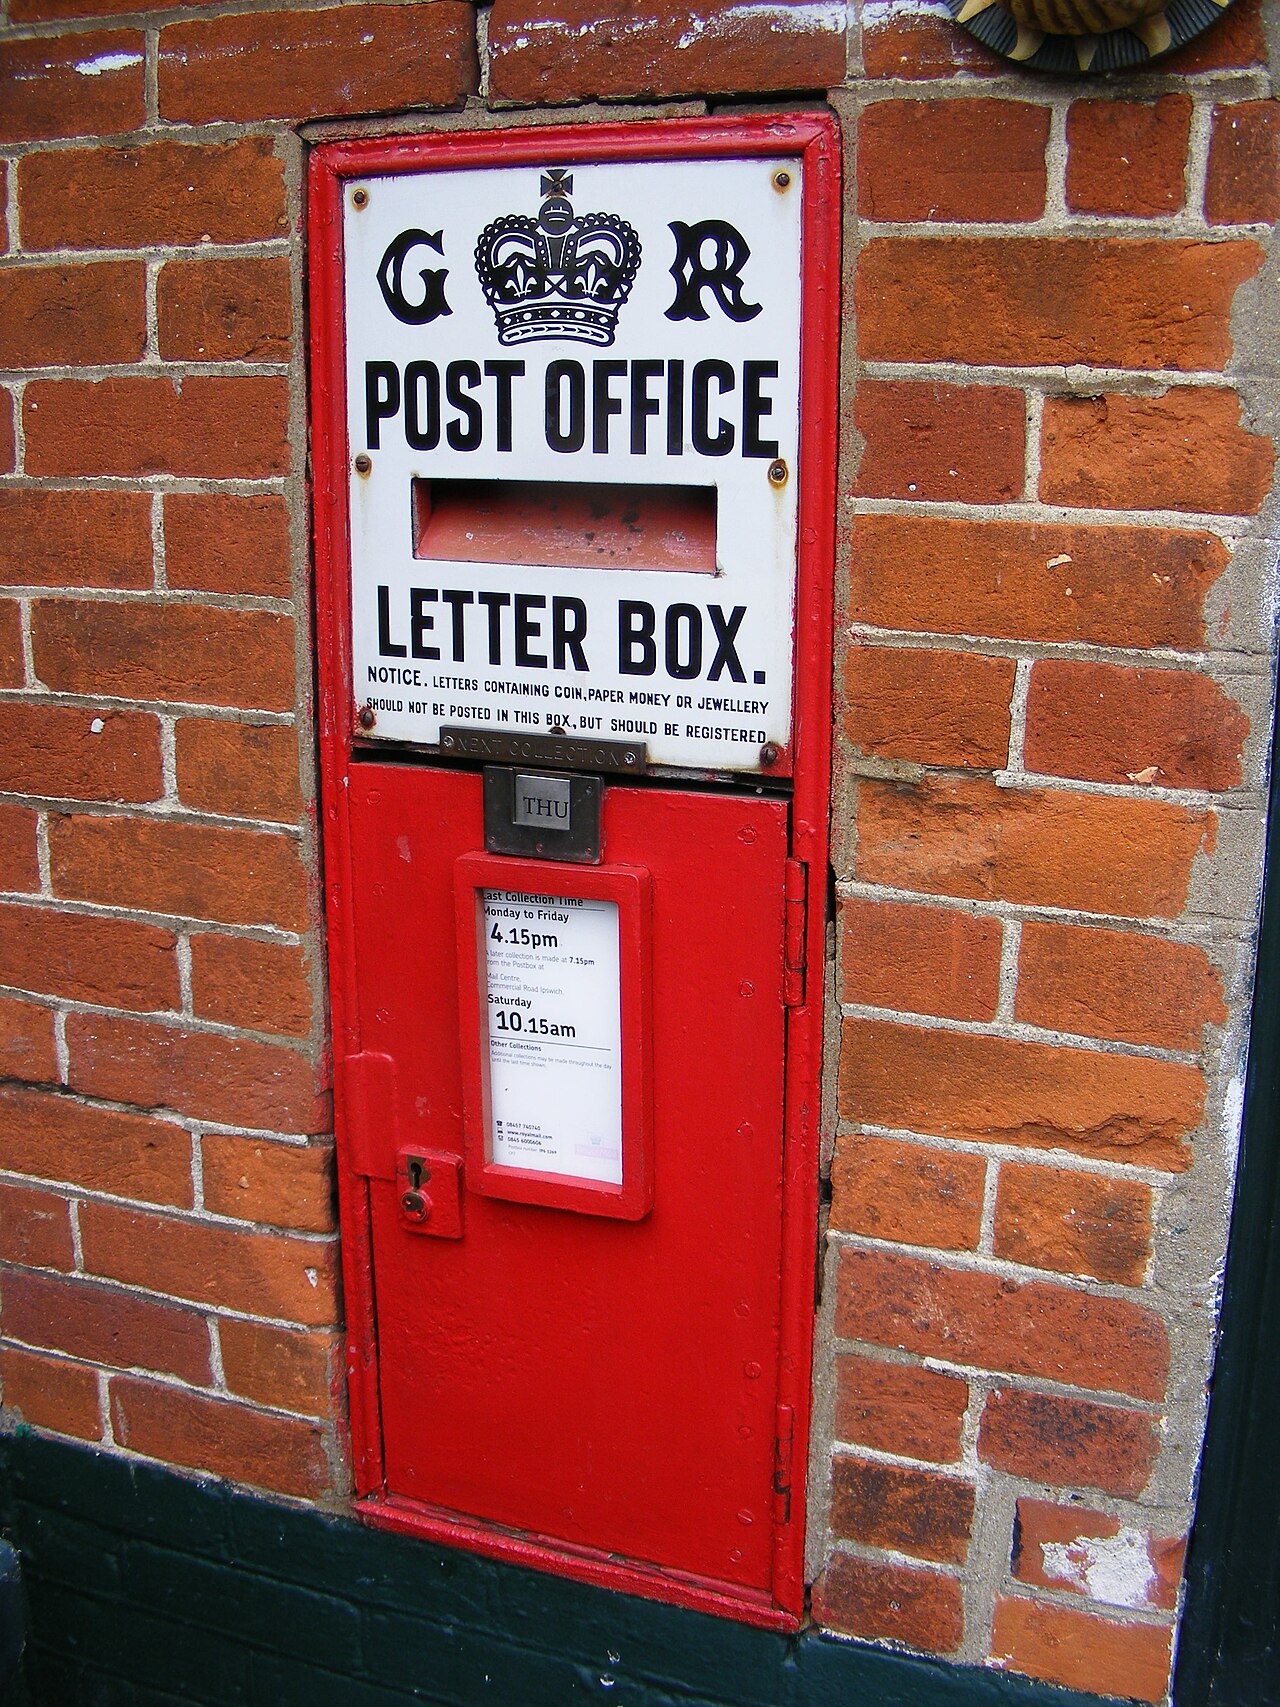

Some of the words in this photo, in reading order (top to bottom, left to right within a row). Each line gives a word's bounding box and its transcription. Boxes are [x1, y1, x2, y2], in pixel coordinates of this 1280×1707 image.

[376, 228, 453, 325] G
[664, 219, 763, 322] R
[365, 360, 525, 452] POST
[544, 359, 779, 458] OFFICE
[377, 585, 589, 672] LETTER
[619, 600, 766, 685] BOX.
[368, 666, 428, 687] NOTICE.
[433, 676, 478, 691] LETTERS
[484, 680, 549, 697] CONTAINING
[629, 692, 671, 707] MONEY
[677, 696, 692, 708] OR
[698, 697, 769, 714] JEWELLERY
[366, 697, 403, 712] SHOULD
[409, 701, 427, 714] NOT
[433, 703, 445, 716] BE
[450, 705, 491, 720] POSTED
[497, 709, 508, 722] IN
[514, 710, 539, 725] THIS
[580, 716, 602, 730] BUT
[611, 718, 657, 734] SHOULD
[665, 723, 679, 736] BE
[686, 725, 766, 744] REGISTERED
[458, 736, 502, 755] NEXT
[510, 741, 620, 766] COLLECTION
[523, 796, 568, 818] THU
[505, 892, 554, 904] Collection
[524, 910, 534, 919] to
[537, 909, 569, 923] Friday
[491, 922, 558, 949] 4.15pm
[506, 952, 533, 960] collection
[569, 956, 595, 966] 7.15pm
[513, 960, 536, 969] Postbox
[487, 981, 521, 991] Commercial
[523, 984, 538, 993] Road
[487, 993, 532, 1009] Saturday
[496, 1010, 576, 1038] 10.15am
[510, 1042, 541, 1051] Collections
[507, 1130, 553, 1139] www.royalmail.com
